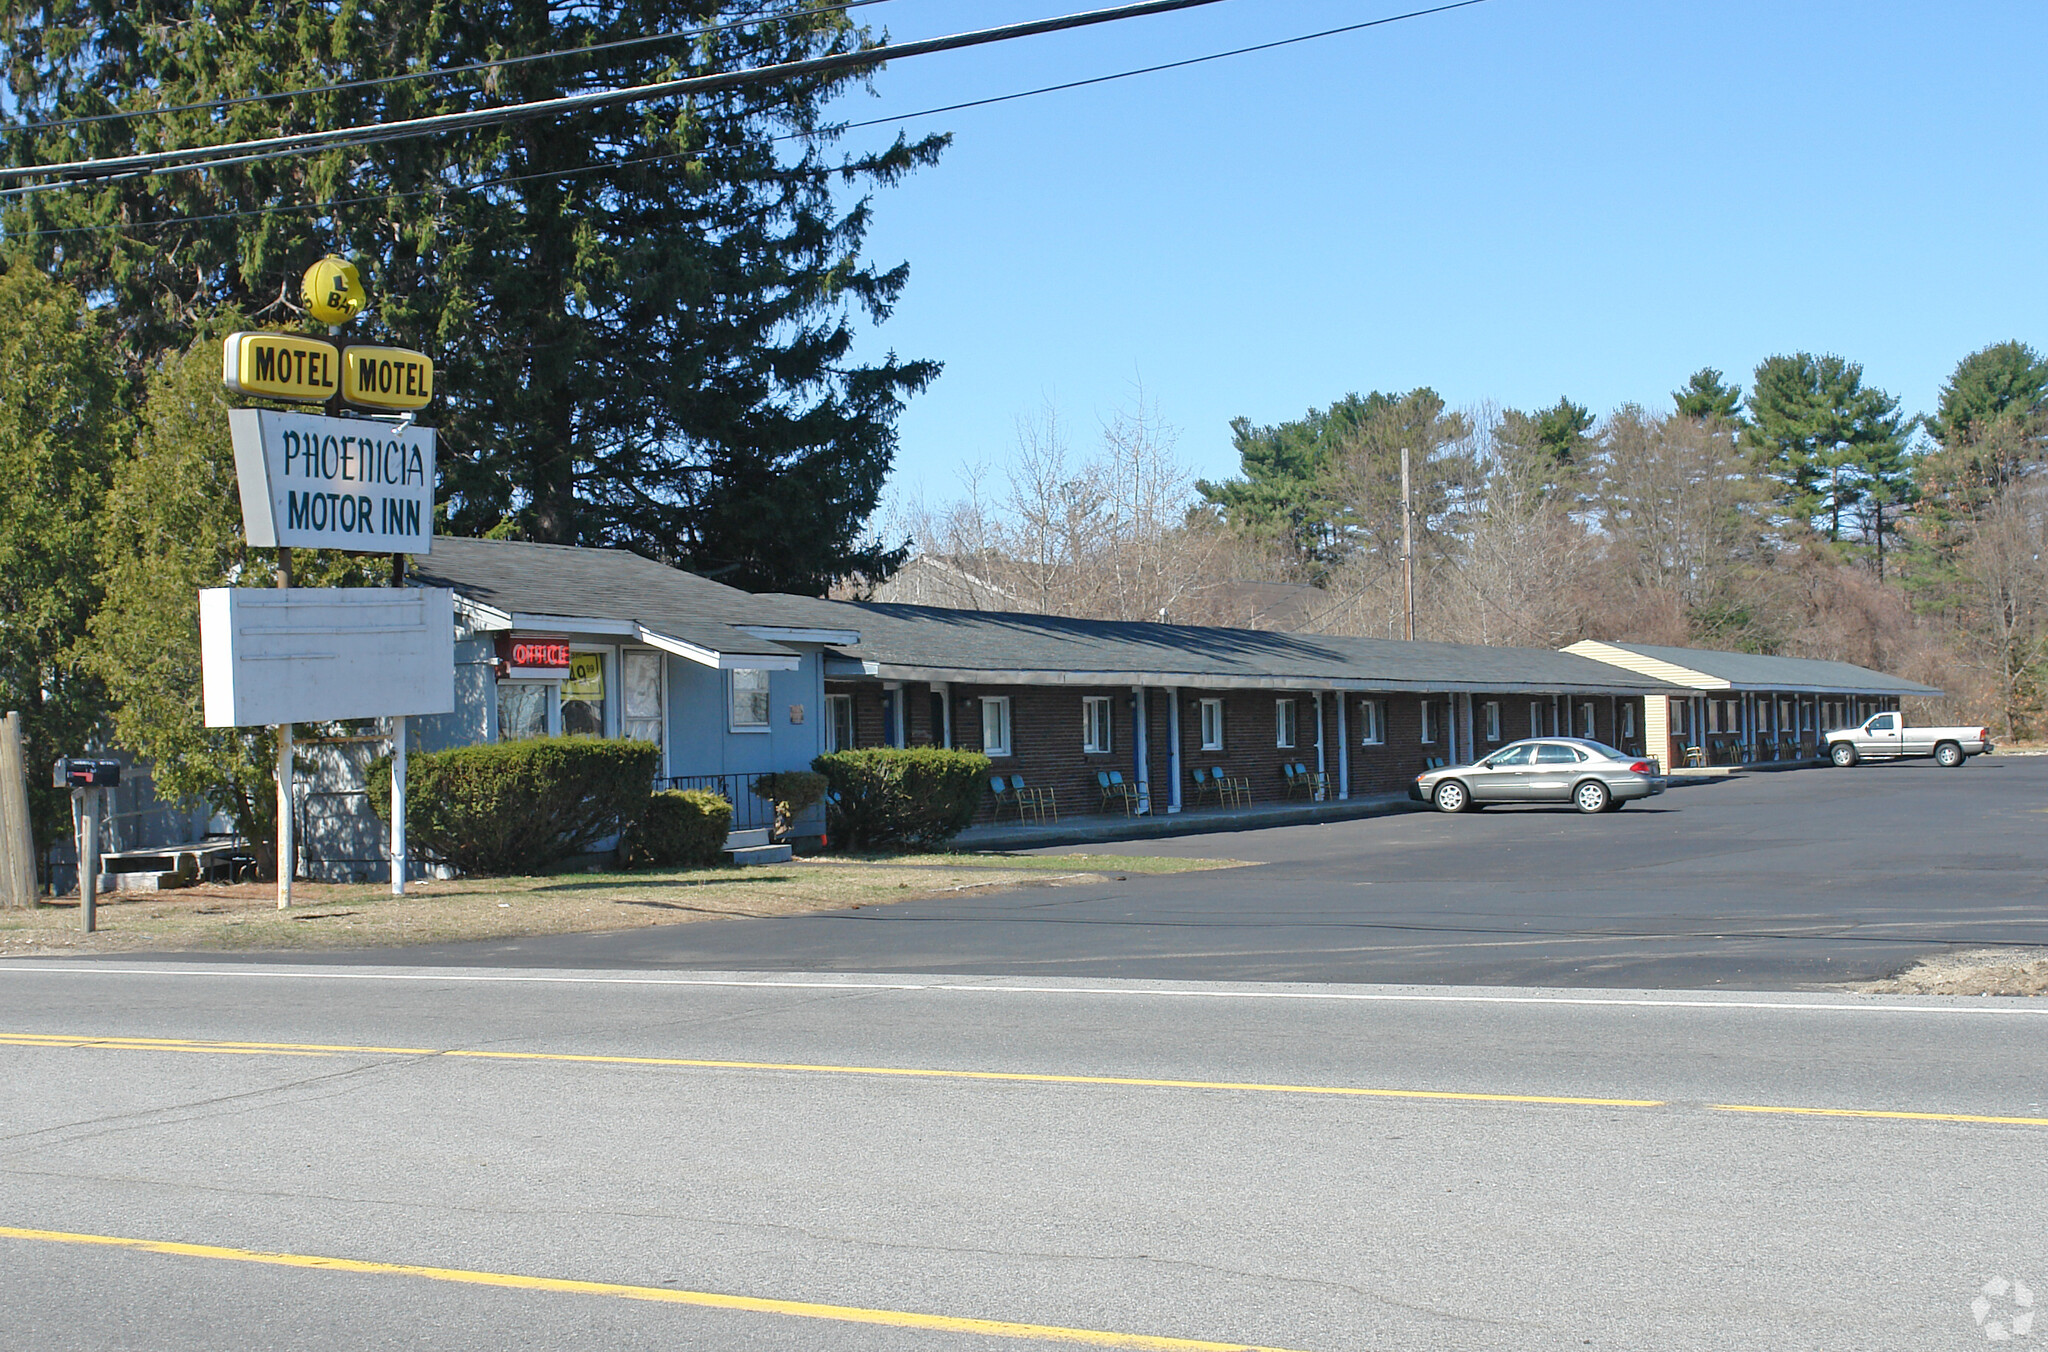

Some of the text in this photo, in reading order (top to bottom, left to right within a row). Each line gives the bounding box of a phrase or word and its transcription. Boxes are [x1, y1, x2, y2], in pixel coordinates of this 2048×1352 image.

[256, 346, 333, 387] MOTEL
[359, 358, 428, 397] MOTEL
[288, 490, 420, 536] MOTOR INN
[513, 644, 569, 664] OFFICE
